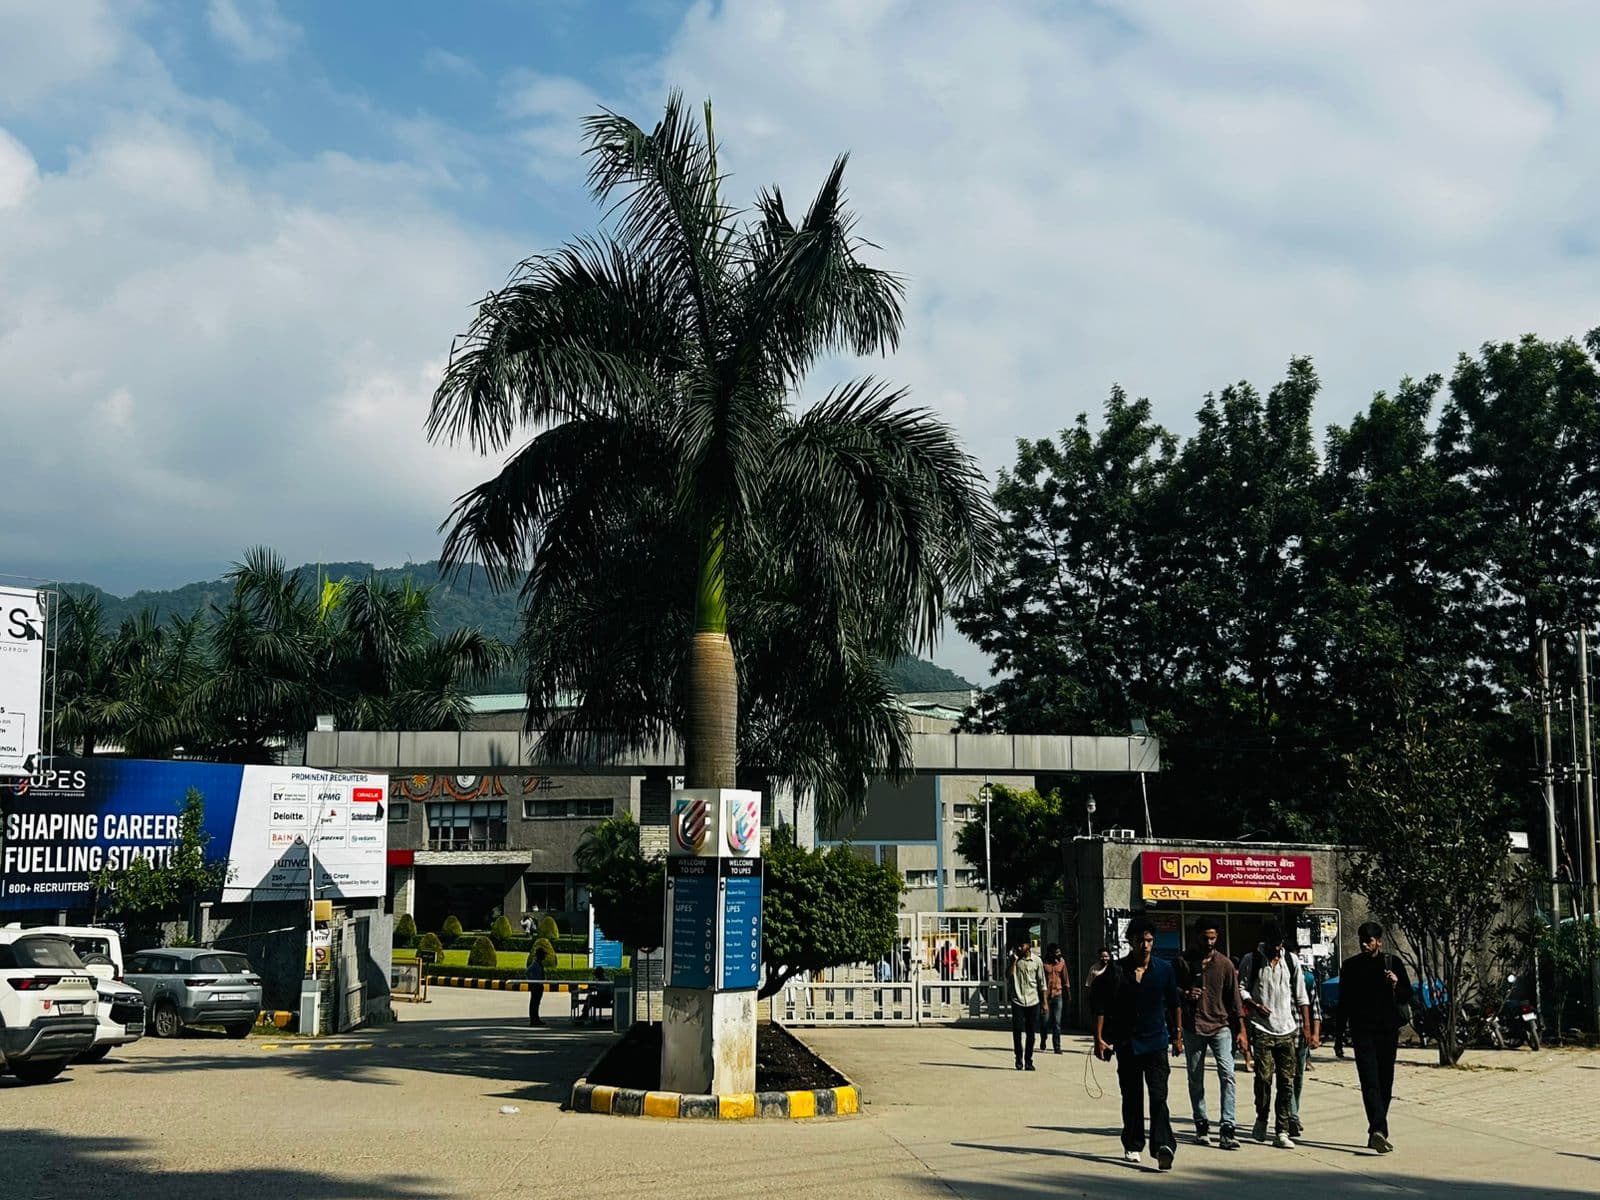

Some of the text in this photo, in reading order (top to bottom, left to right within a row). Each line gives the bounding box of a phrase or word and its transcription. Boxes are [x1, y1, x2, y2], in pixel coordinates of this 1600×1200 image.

[30, 770, 86, 789] UPES
[291, 772, 368, 783] PROMINENT RECRUITERS
[273, 793, 283, 801] EY
[317, 793, 341, 801] KPMG
[7, 813, 98, 841] SHAPING
[272, 833, 293, 841] BAIN
[4, 845, 202, 874] FUELLING STARTU
[273, 858, 309, 868] runwa
[1215, 857, 1243, 866] पंजाब
[1182, 863, 1208, 877] pnb
[1216, 872, 1296, 881] punjab national bank
[8, 882, 90, 894] 800+ RECRUITERS
[1150, 888, 1190, 900] एटीएम
[1268, 890, 1308, 902] ATM
[675, 904, 693, 912] UPES
[727, 905, 740, 913] UPES
